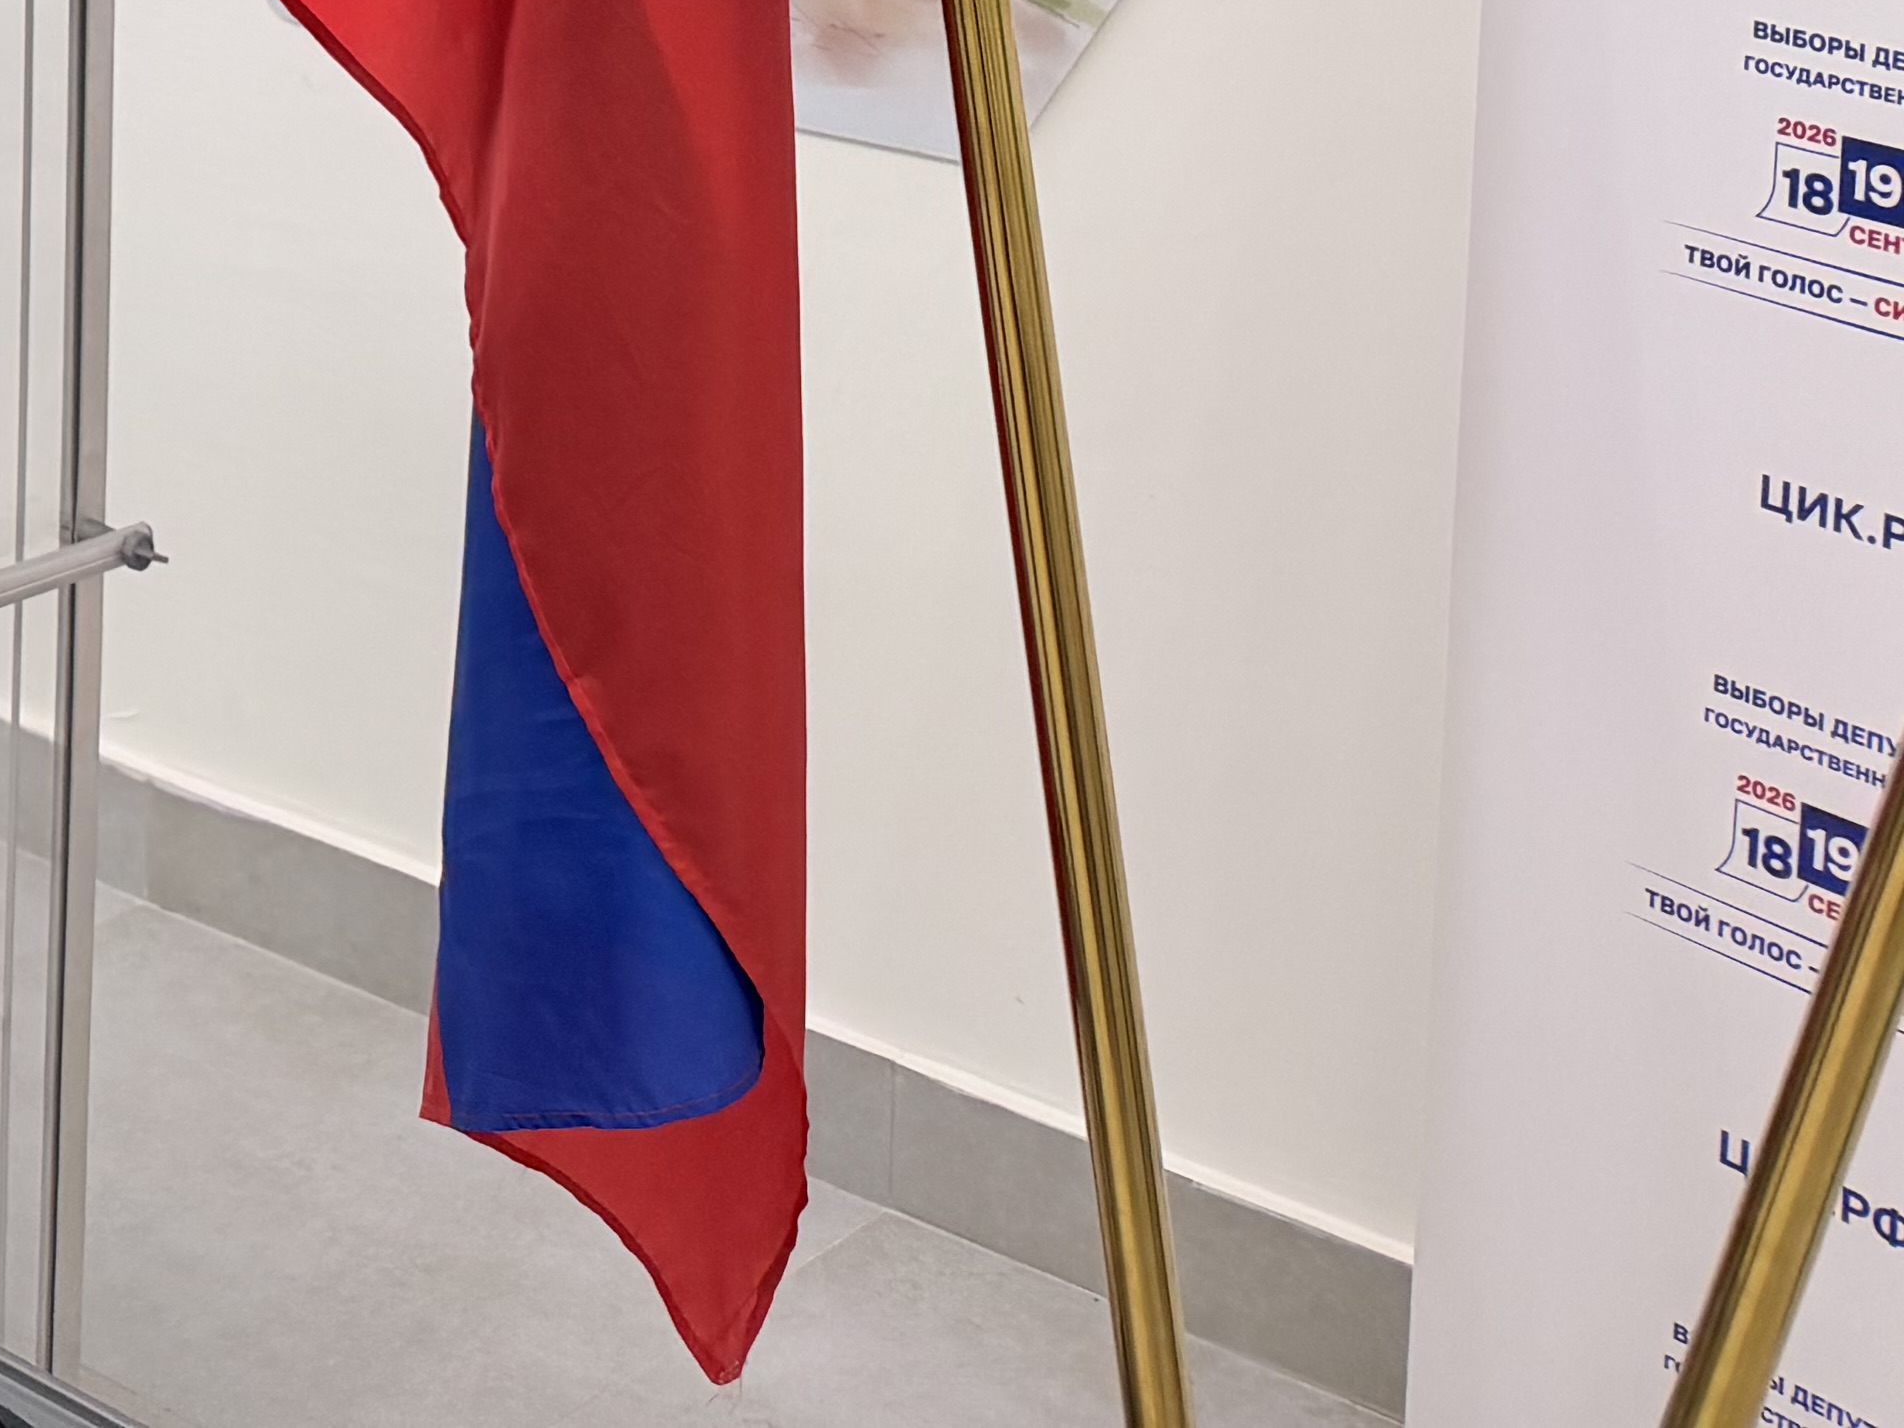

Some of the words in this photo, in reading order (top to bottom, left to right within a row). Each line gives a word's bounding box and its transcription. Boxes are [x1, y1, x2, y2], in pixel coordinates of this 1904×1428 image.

[1753, 20, 1865, 62] ВЫБОРЫ
[1776, 117, 1837, 147] 2026
[1782, 167, 1834, 216] 18
[1848, 159, 1902, 209] 19
[1849, 225, 1904, 255] СЕН
[1684, 244, 1752, 280] ТВОЙ
[1757, 264, 1843, 304] ГОЛОС
[1714, 674, 1825, 731] ВЫБОРЫ
[1737, 775, 1796, 812] 2026
[1742, 827, 1792, 879] 18
[1806, 828, 1860, 882] 19
[1645, 888, 1711, 931] ТВОЙ
[1718, 920, 1803, 970] ГОЛОС
